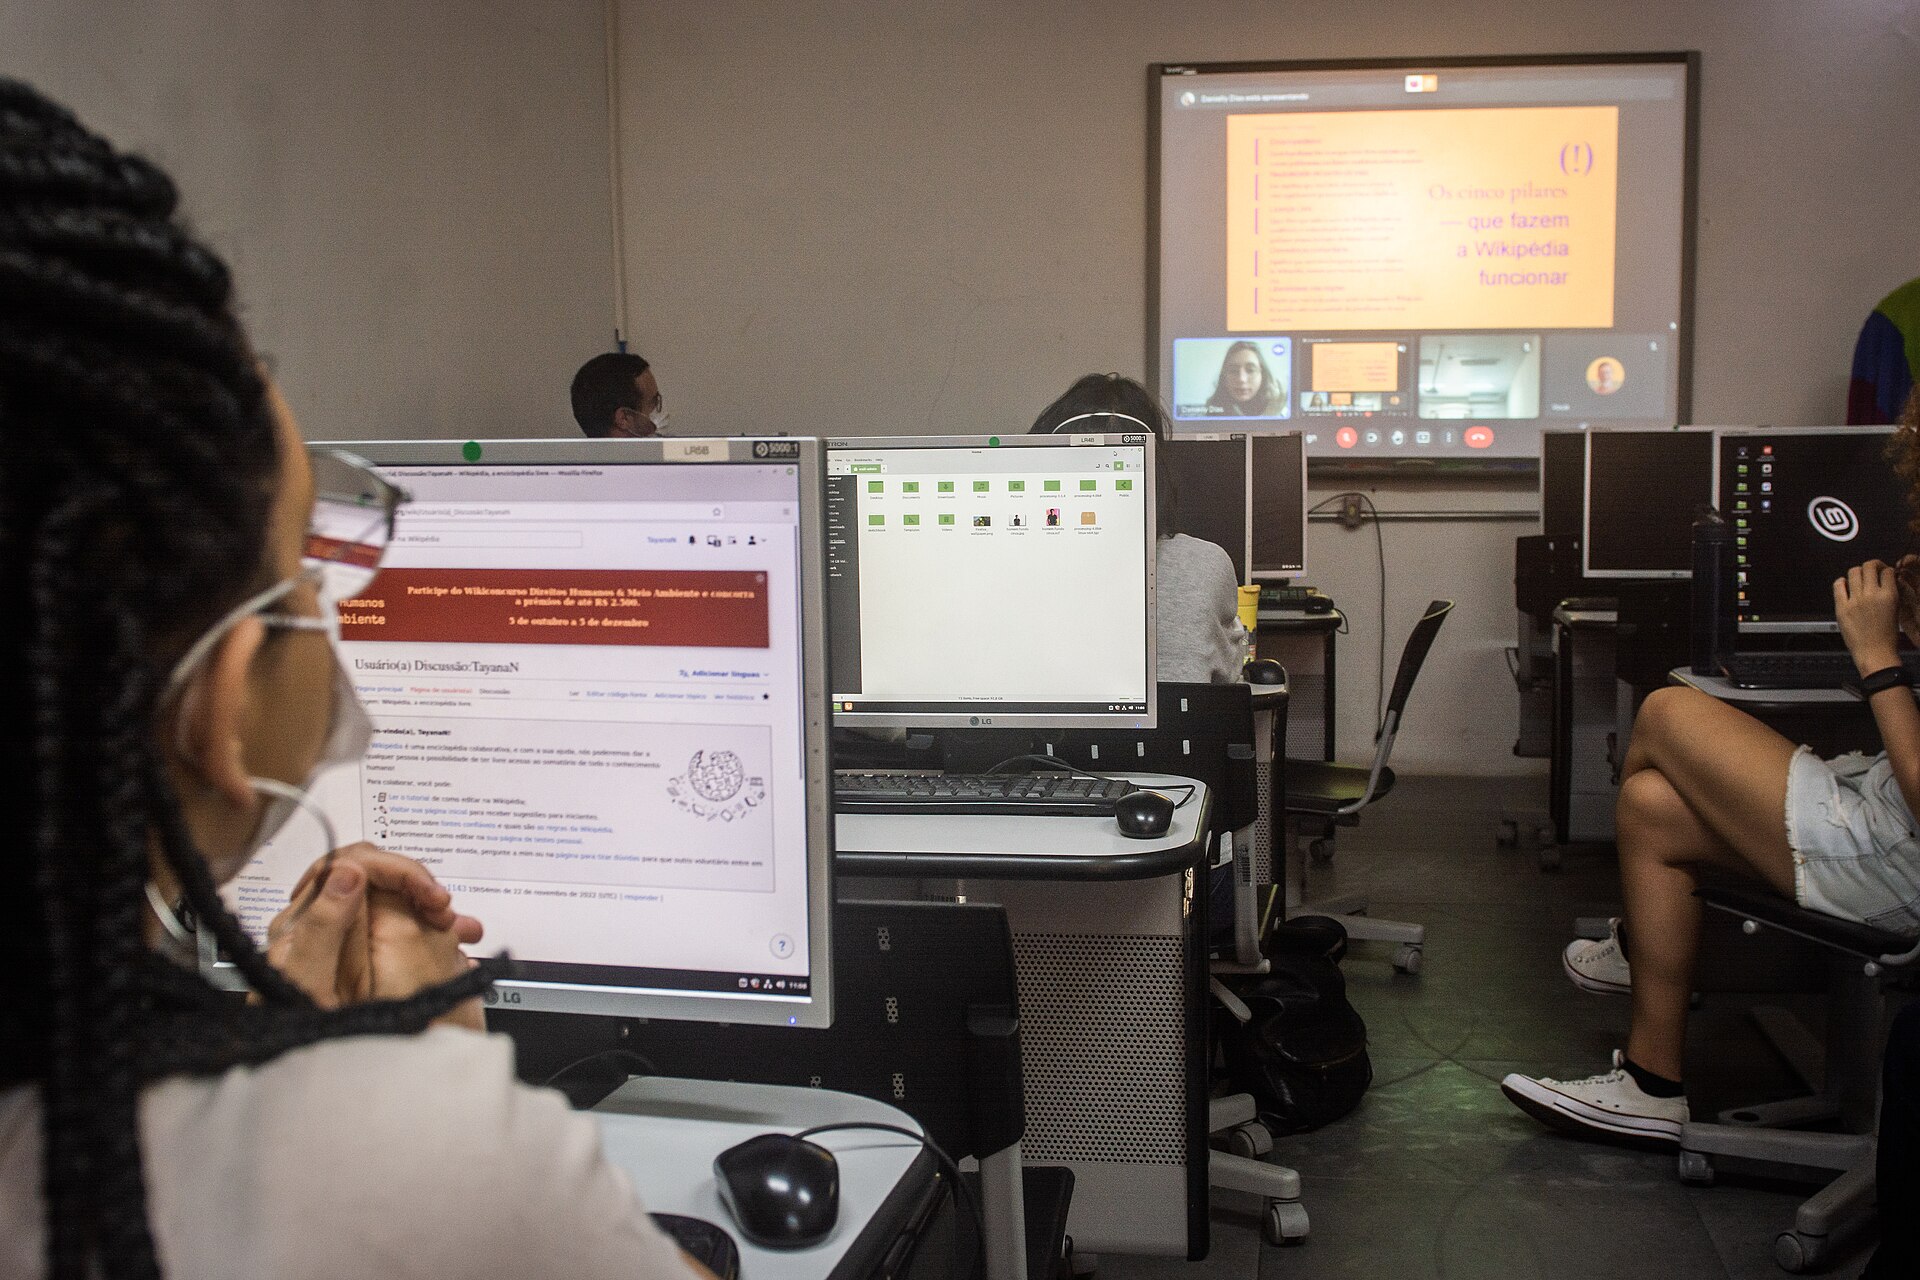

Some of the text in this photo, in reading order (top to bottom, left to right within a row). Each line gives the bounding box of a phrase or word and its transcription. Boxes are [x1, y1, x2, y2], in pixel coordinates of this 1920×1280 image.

[1428, 178, 1568, 204] Os cinco pilares
[1468, 212, 1570, 232] que fazem
[1456, 240, 1570, 260] a Wikipédia
[1479, 269, 1568, 286] funcionar
[408, 586, 448, 596] Participe
[450, 586, 462, 596] do
[464, 586, 528, 596] Wikiconcurso
[529, 588, 568, 596] Direitos
[569, 588, 614, 597] Humanos
[627, 588, 652, 598] Meio
[654, 589, 700, 598] Ambiente
[710, 591, 755, 599] concorra
[524, 597, 562, 607] prêmios
[563, 598, 575, 606] de
[577, 598, 592, 606] até
[336, 614, 386, 626] mbiente
[509, 617, 515, 626] 5
[517, 616, 529, 626] de
[531, 617, 569, 626] outubro
[580, 618, 586, 626] 5
[587, 618, 600, 627] de
[601, 618, 650, 628] dezembro
[354, 658, 520, 675] Usuário(a) Discussão:TayanaN
[446, 884, 467, 892] 1143
[503, 992, 521, 1004] LG
